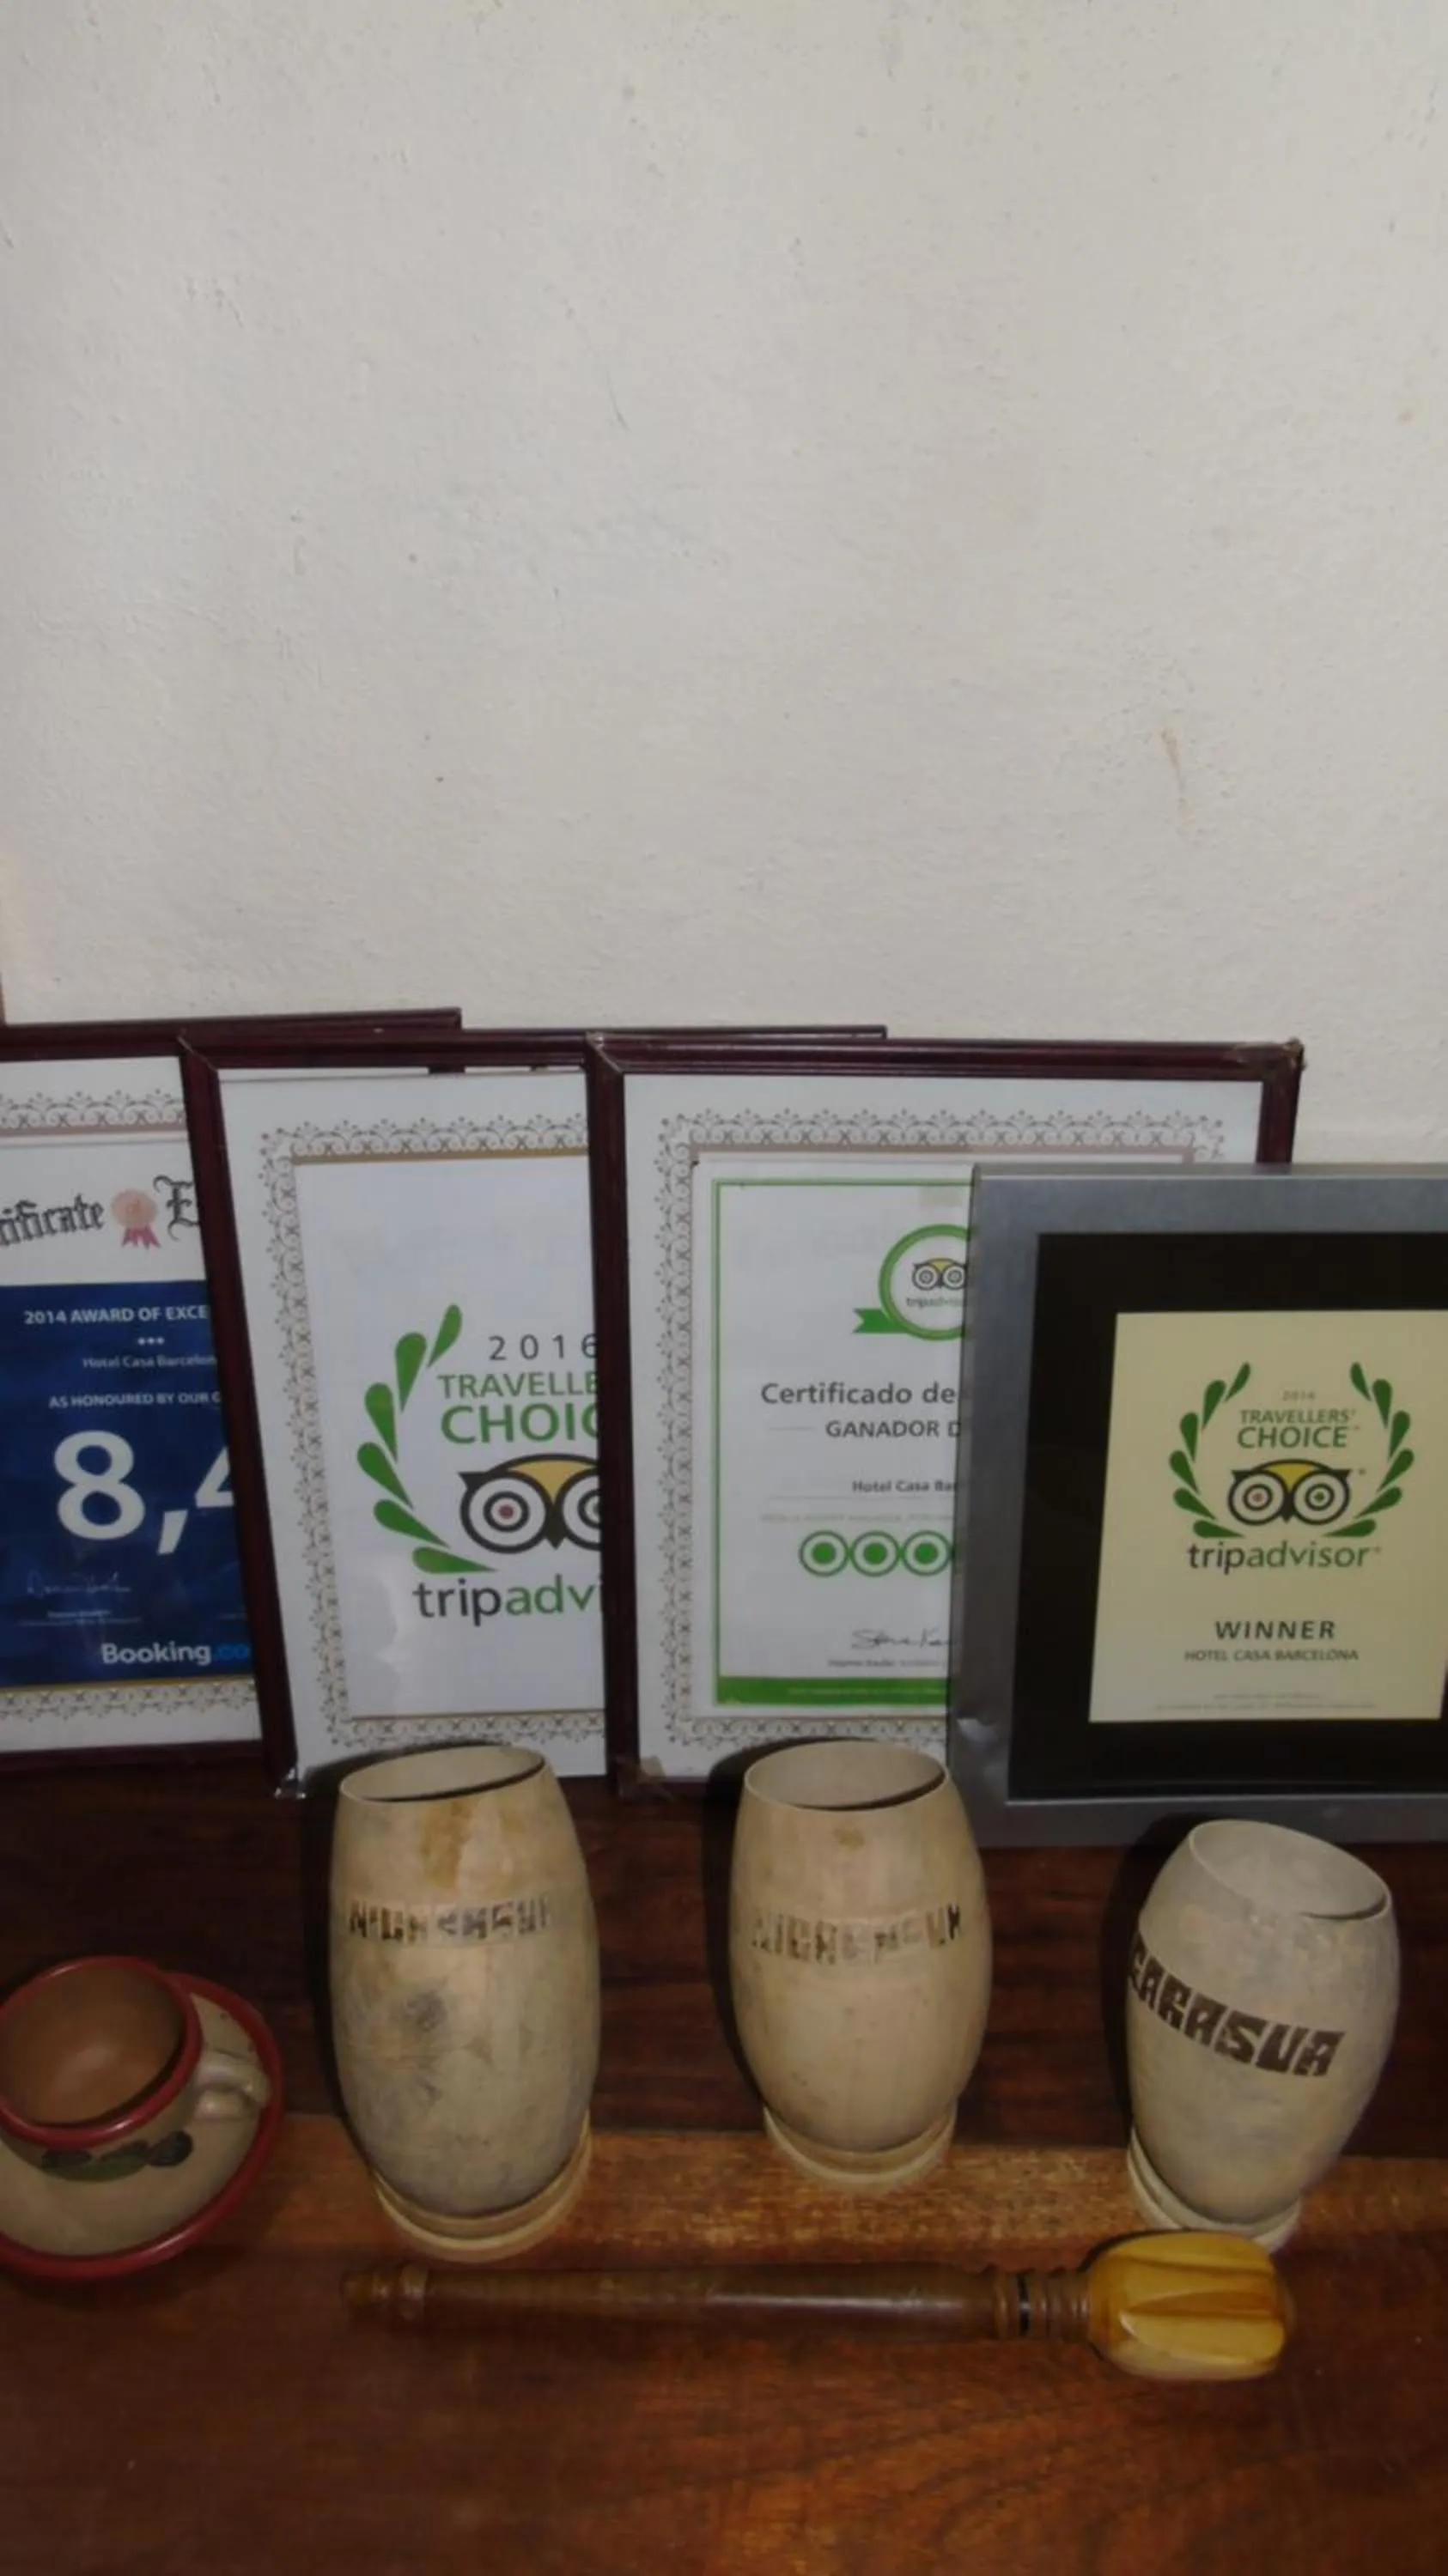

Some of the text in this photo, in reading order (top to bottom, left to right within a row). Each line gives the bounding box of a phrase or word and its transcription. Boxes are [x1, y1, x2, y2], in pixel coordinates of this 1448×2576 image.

[23, 1310, 67, 1325] 2014
[70, 1308, 134, 1324] AWARD
[137, 1306, 161, 1321] OF
[489, 1334, 599, 1361] 2016
[49, 1397, 69, 1408] AS
[72, 1394, 154, 1408] HONOURED
[156, 1394, 174, 1406] BY
[178, 1392, 210, 1405] OUR
[761, 1382, 956, 1405] Certificado de
[825, 1419, 940, 1438] GANADOR
[852, 1479, 891, 1492] Hotel
[895, 1480, 930, 1492] Casa
[1214, 1620, 1335, 1640] WINNER
[1184, 1649, 1360, 1662] HOTEL CASA BARCELONA
